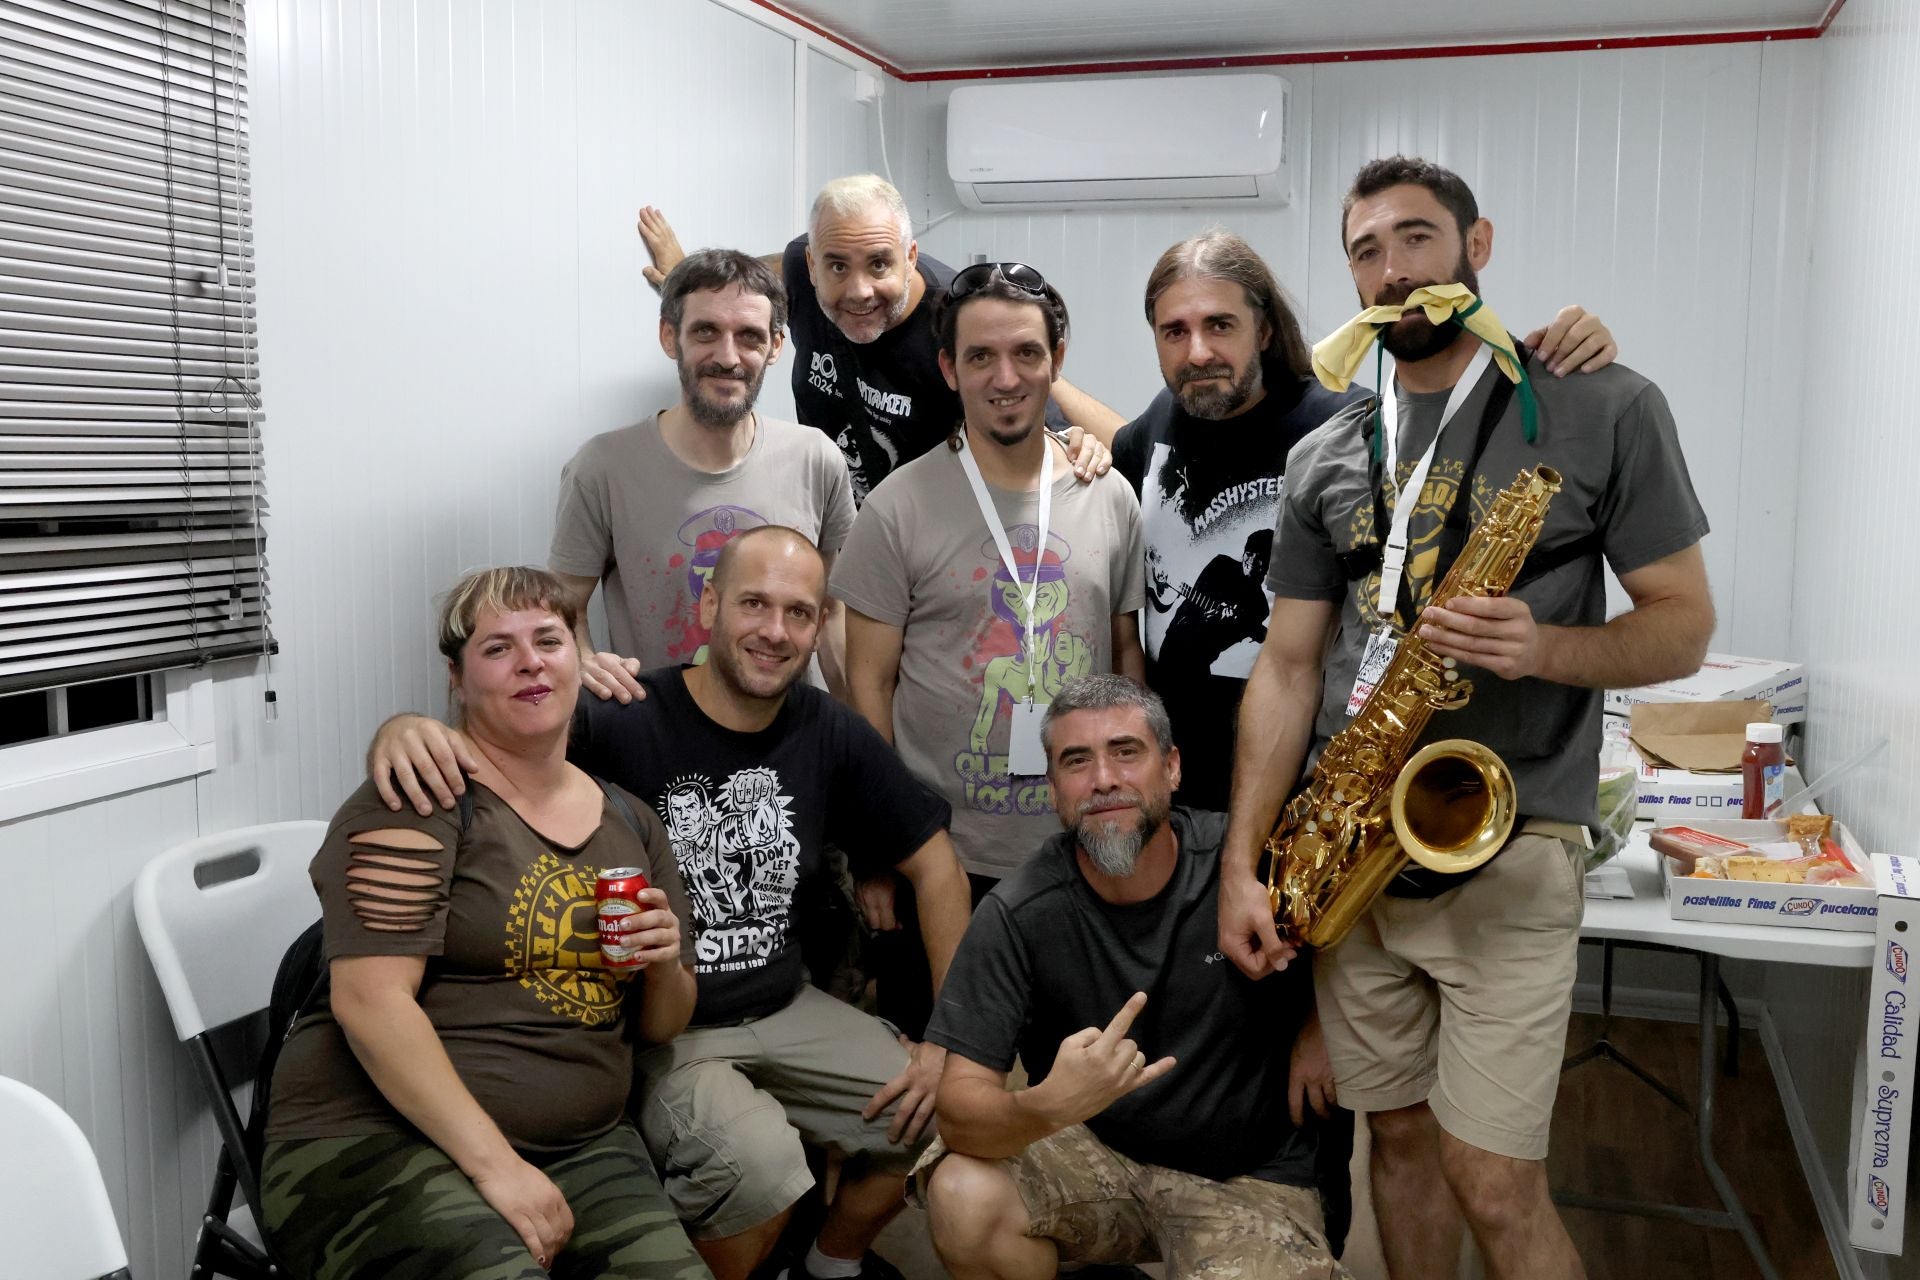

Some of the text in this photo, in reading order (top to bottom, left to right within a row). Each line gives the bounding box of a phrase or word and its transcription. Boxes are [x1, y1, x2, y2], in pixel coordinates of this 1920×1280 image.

[808, 371, 833, 396] 2024
[1194, 475, 1285, 535] MASSHYSTER
[1638, 795, 1664, 804] elillos
[753, 840, 795, 868] DON'T
[772, 860, 791, 871] LET
[763, 870, 786, 884] THE
[752, 881, 792, 895] BASTARDS
[1683, 896, 1742, 907] pastelillos
[1747, 898, 1776, 910] Finos
[1787, 900, 1814, 912] CUNDO
[598, 918, 621, 932] Mah
[695, 923, 786, 963] STERS!
[720, 961, 747, 973] SINCE
[1892, 947, 1906, 974] CUNDO
[1872, 990, 1906, 1168] Calidad Suprema
[1873, 1181, 1887, 1208] CUNDO
